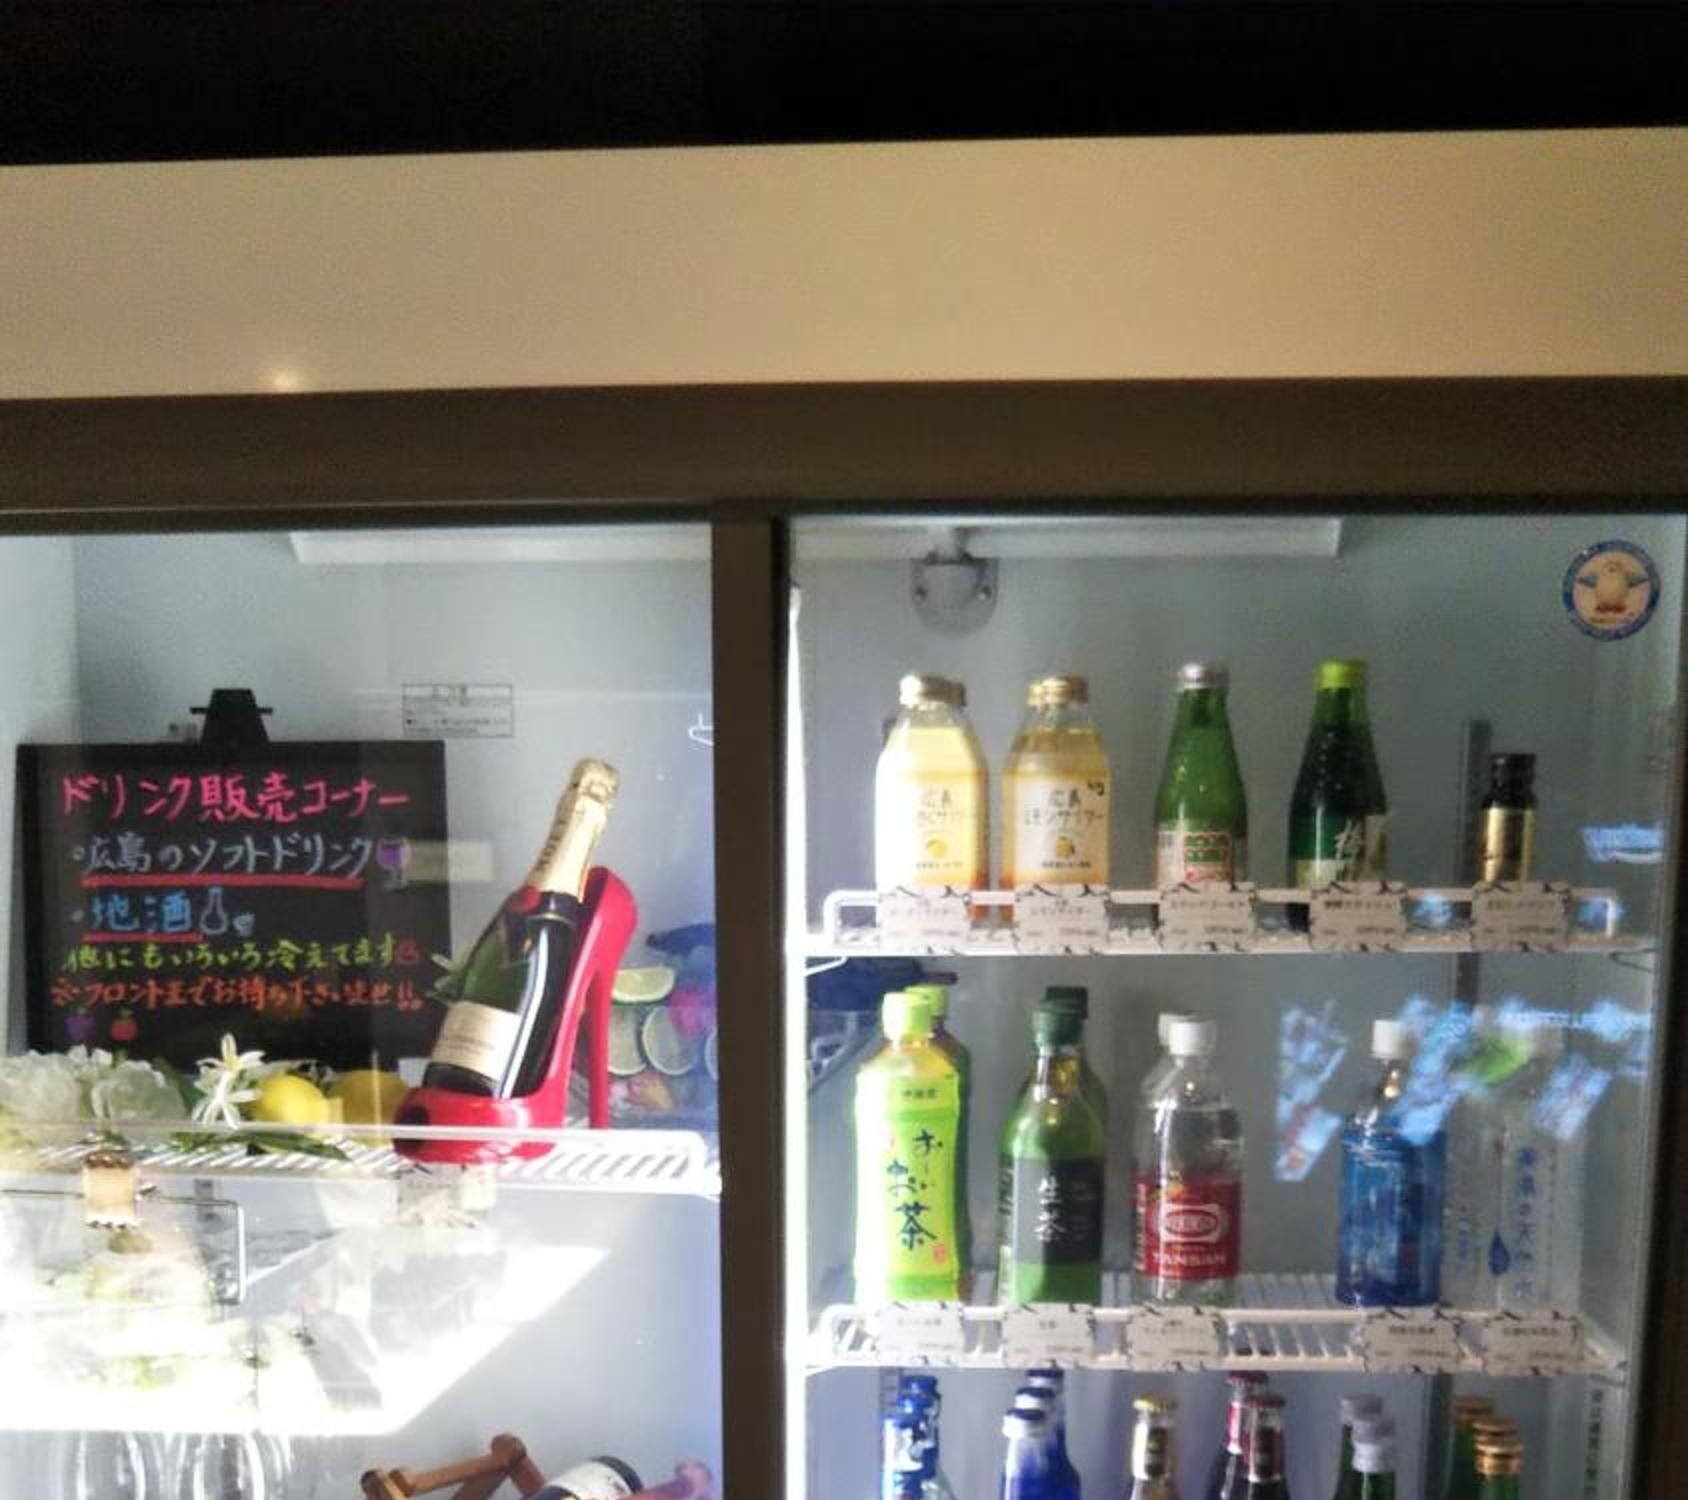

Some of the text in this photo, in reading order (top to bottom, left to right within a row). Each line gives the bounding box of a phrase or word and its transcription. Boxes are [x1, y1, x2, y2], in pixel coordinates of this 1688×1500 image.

[62, 772, 411, 823] ドリンク販売コーナー
